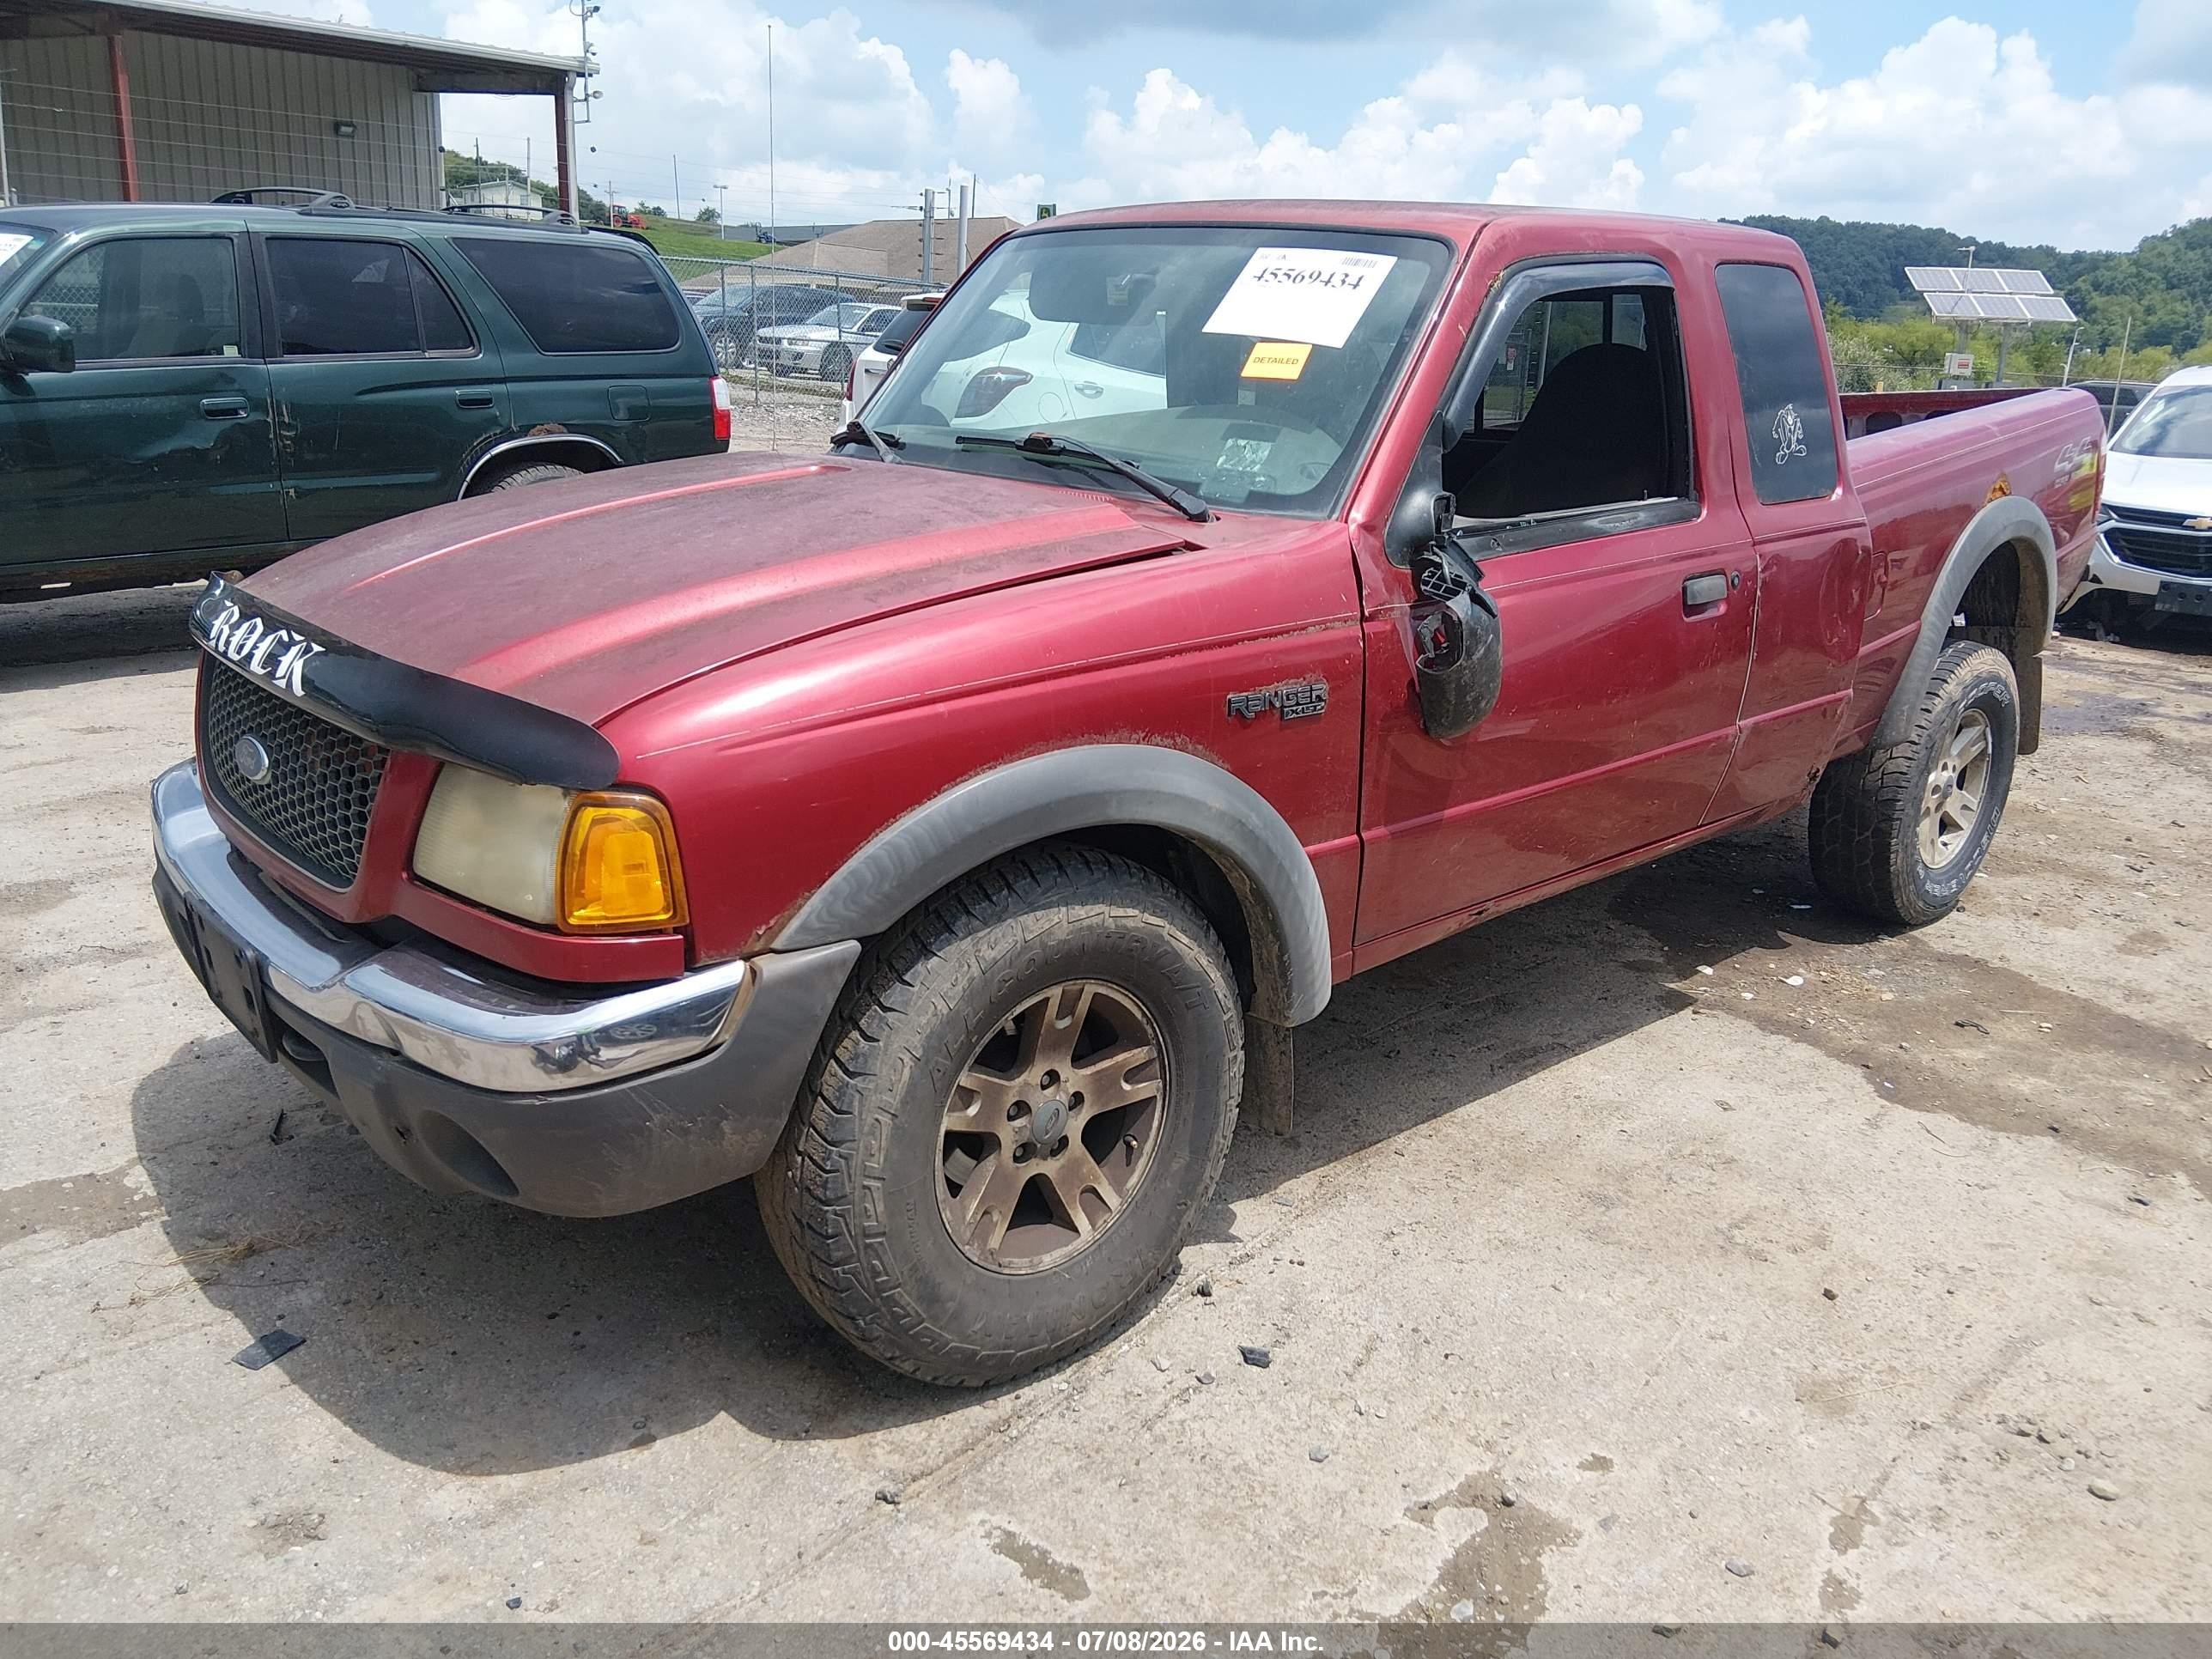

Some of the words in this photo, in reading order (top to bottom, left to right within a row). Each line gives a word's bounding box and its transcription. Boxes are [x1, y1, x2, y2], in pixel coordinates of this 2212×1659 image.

[1253, 267, 1364, 290] 45569434
[1252, 356, 1299, 366] DETAILED
[207, 599, 326, 697] ROCK
[1230, 684, 1327, 719] RANGER
[1286, 703, 1325, 718] XLT
